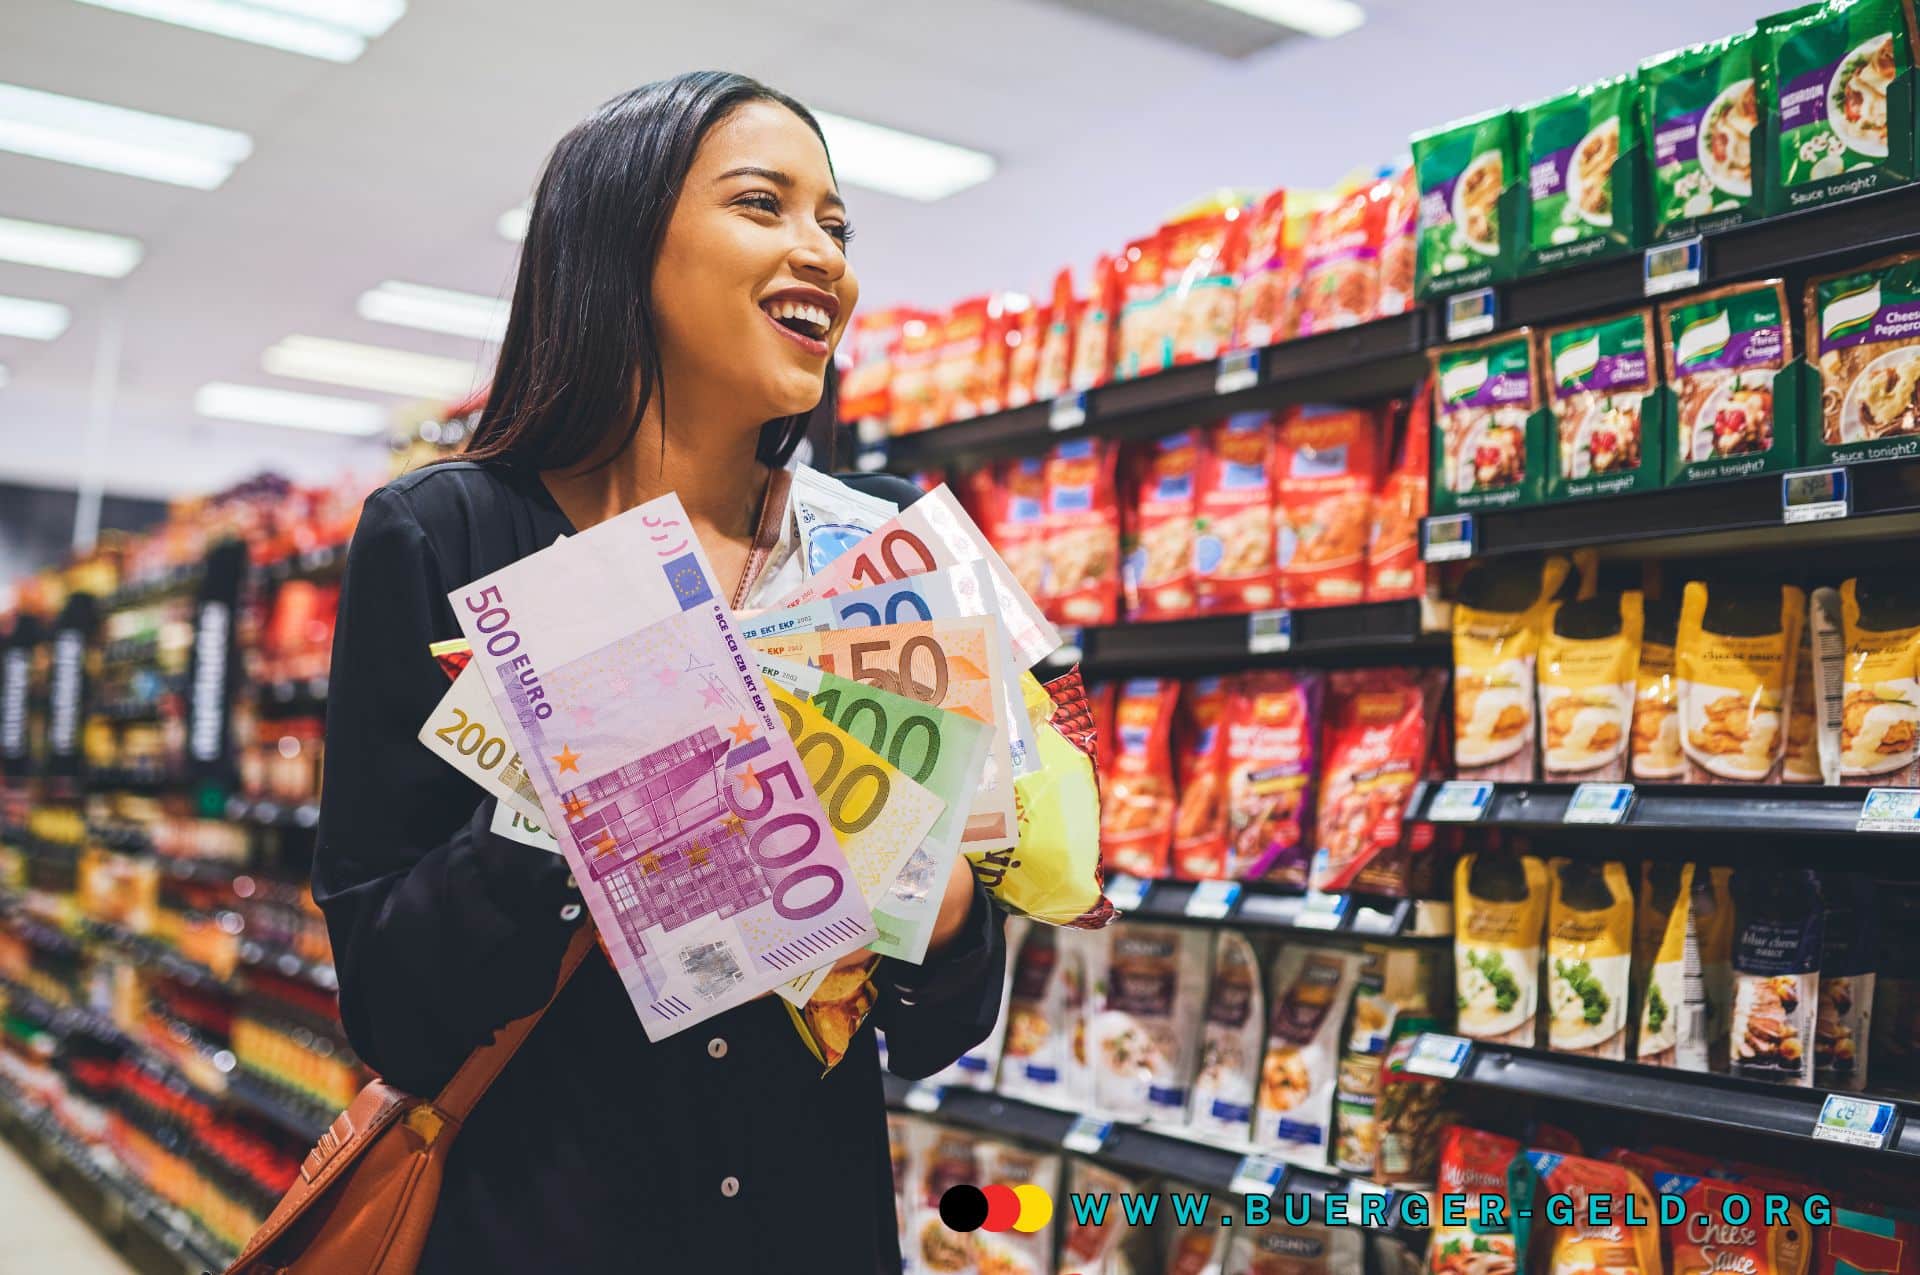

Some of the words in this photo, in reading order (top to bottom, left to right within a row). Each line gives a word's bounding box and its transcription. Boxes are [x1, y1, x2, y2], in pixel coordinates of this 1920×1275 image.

[1791, 189, 1824, 205] Sauce
[1828, 174, 1877, 194] tonight?
[1831, 449, 1864, 464] Sauce
[1868, 442, 1917, 460] tonight?
[1688, 467, 1717, 480] Sauce
[1721, 459, 1764, 477] tonight?
[761, 625, 776, 635] EKT
[779, 620, 794, 630] EKP
[466, 585, 520, 656] 500
[512, 653, 552, 720] EURO
[767, 647, 785, 655] EKP
[715, 613, 729, 631] BCE
[725, 634, 738, 653] ECB
[734, 654, 747, 673] EZB
[744, 674, 757, 692] EKT
[752, 694, 766, 712] EKP
[763, 714, 775, 730] 2002
[762, 666, 780, 677] EKP
[850, 635, 949, 707] 50
[435, 708, 506, 770] 200
[813, 688, 941, 784] 100
[722, 759, 844, 921] 500
[1687, 1212, 1757, 1246] Cheese
[1699, 1245, 1757, 1274] Sauce
